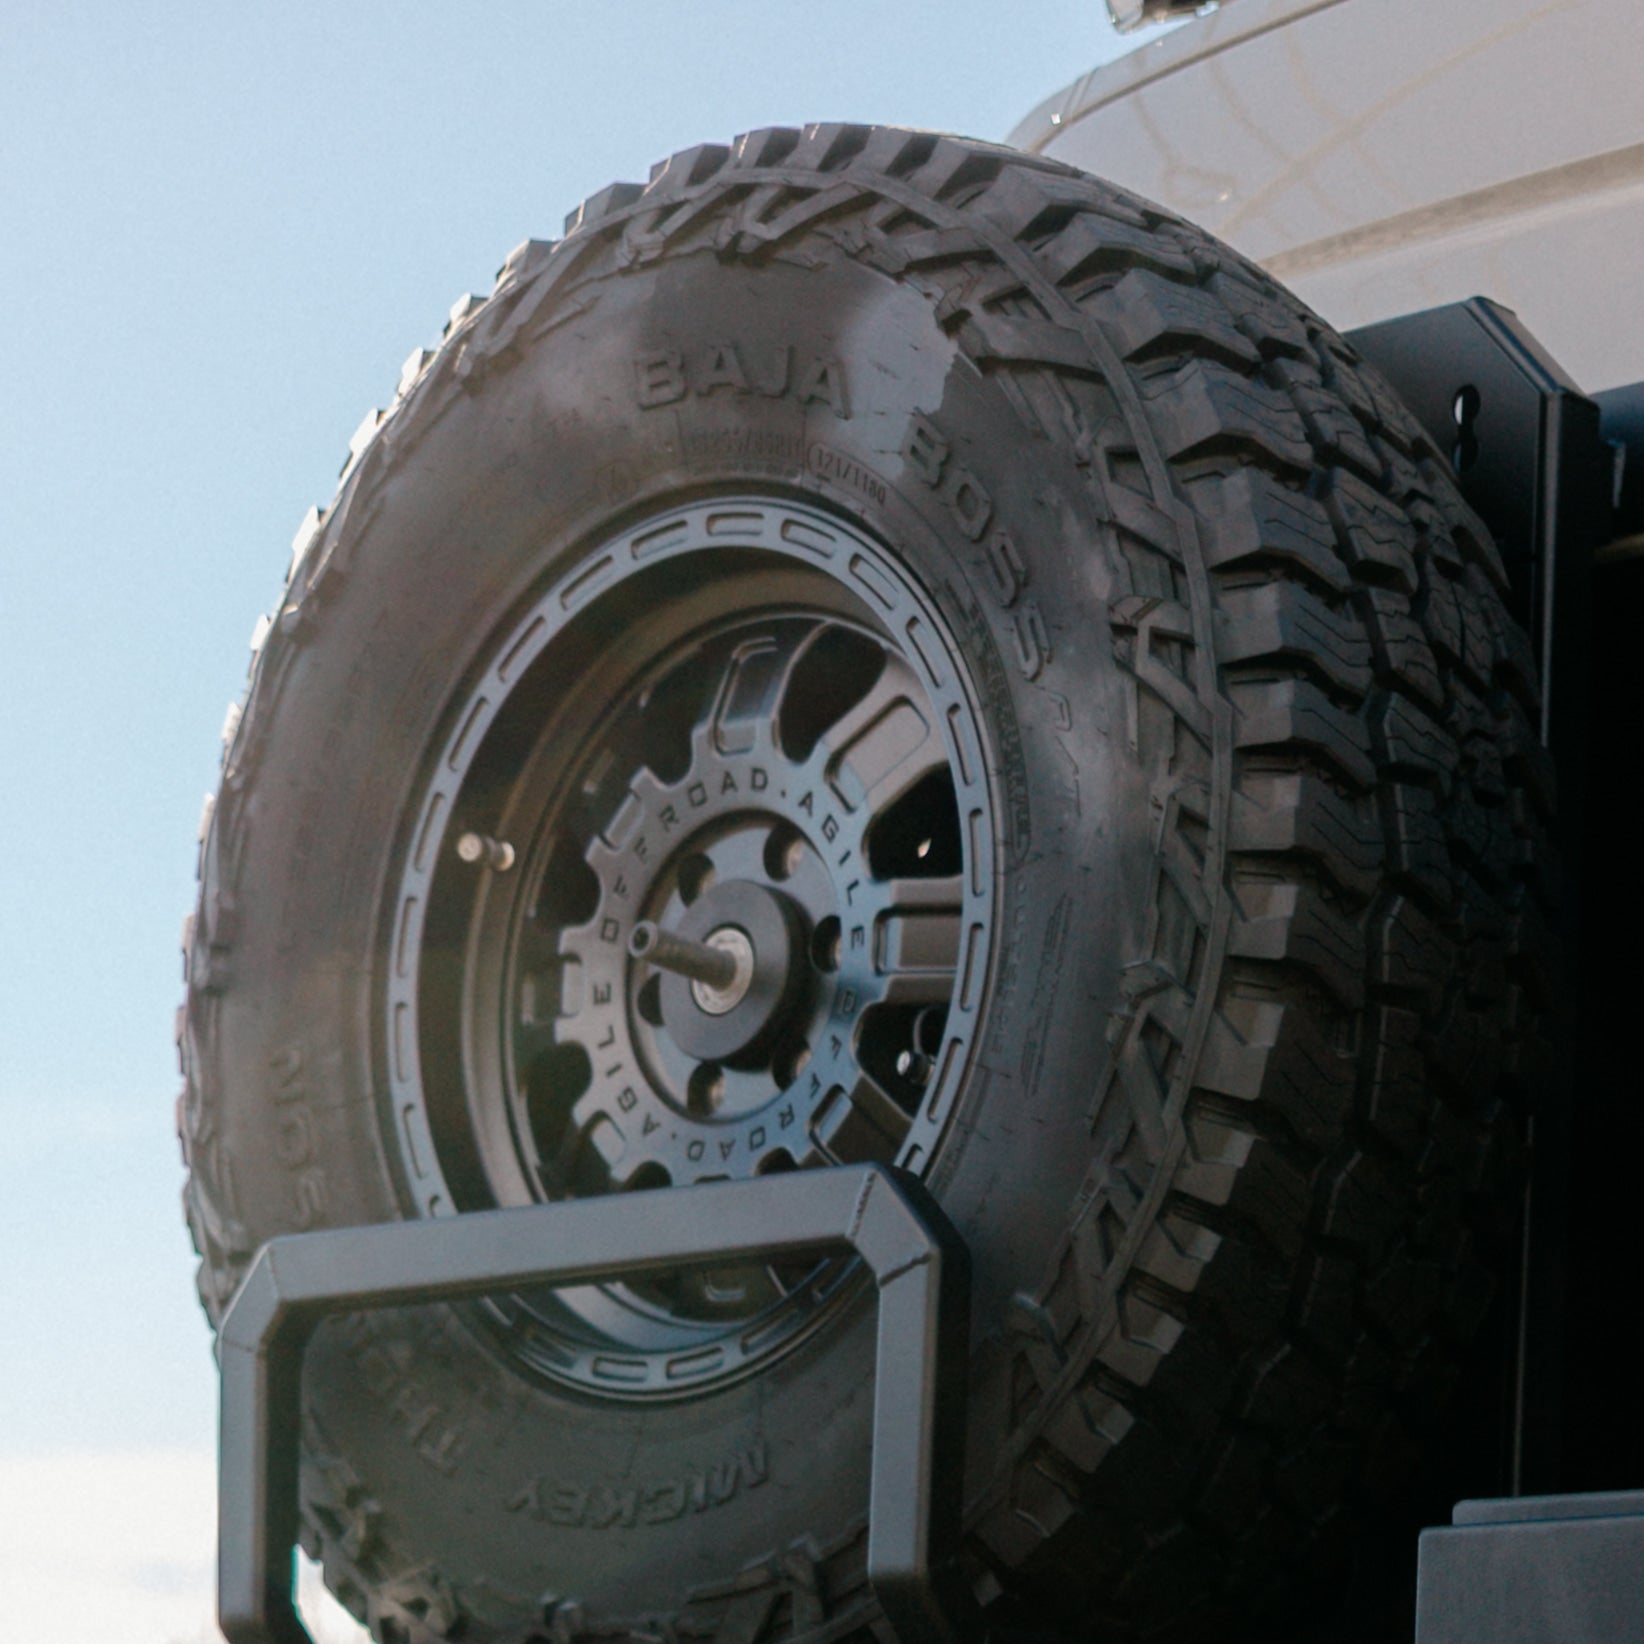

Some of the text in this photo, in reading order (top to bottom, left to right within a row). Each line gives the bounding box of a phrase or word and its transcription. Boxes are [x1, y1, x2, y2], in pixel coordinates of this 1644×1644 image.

[636, 343, 852, 421] BAJA
[907, 404, 1054, 685] BOSS
[504, 1430, 770, 1530] MICKEY
